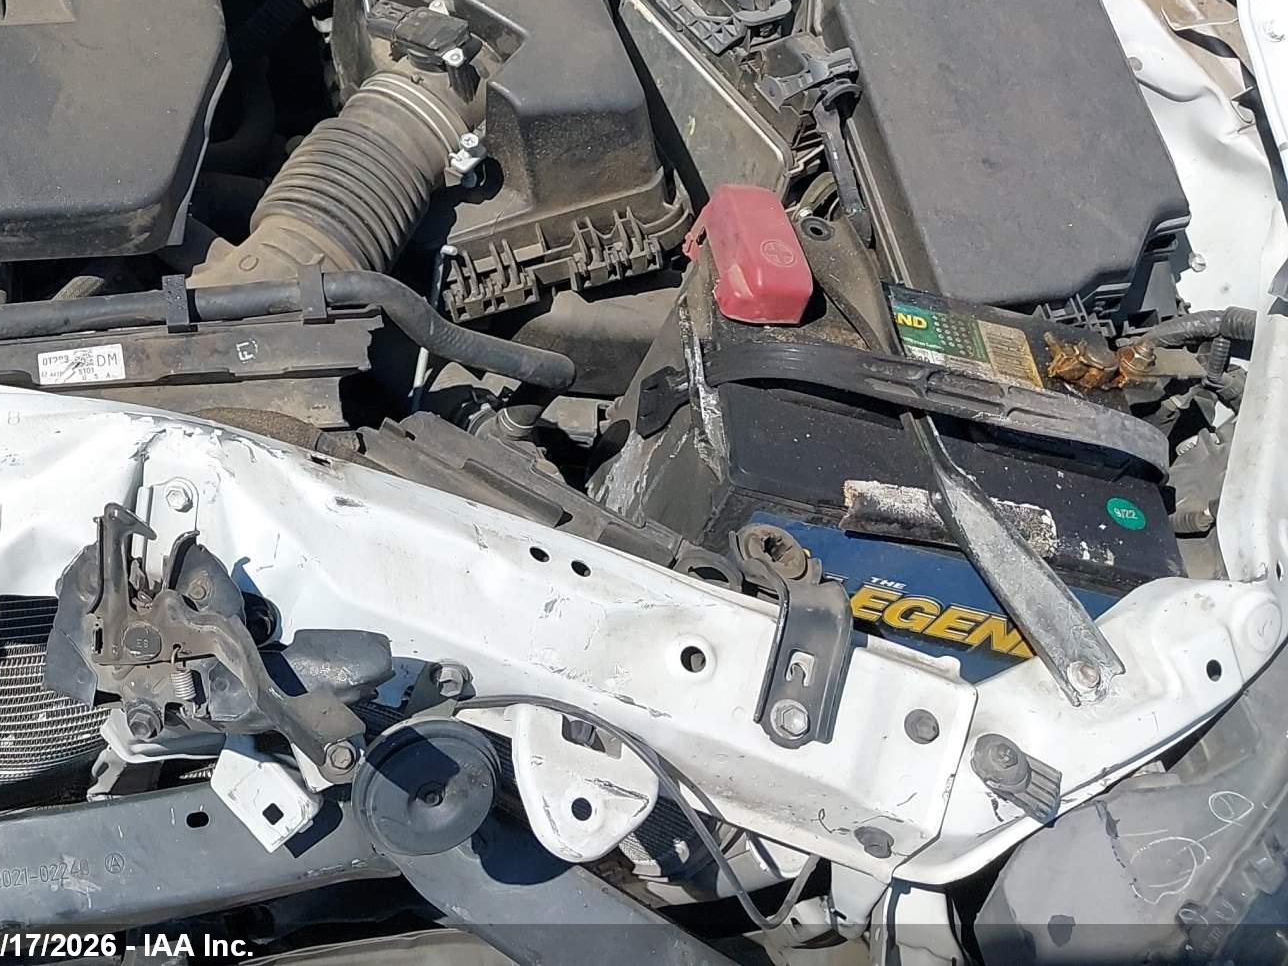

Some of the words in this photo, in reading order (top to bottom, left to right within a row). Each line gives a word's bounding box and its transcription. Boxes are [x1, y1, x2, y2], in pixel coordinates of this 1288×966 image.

[97, 353, 118, 367] DM
[870, 576, 908, 590] THE
[849, 584, 1036, 659] EGEN
